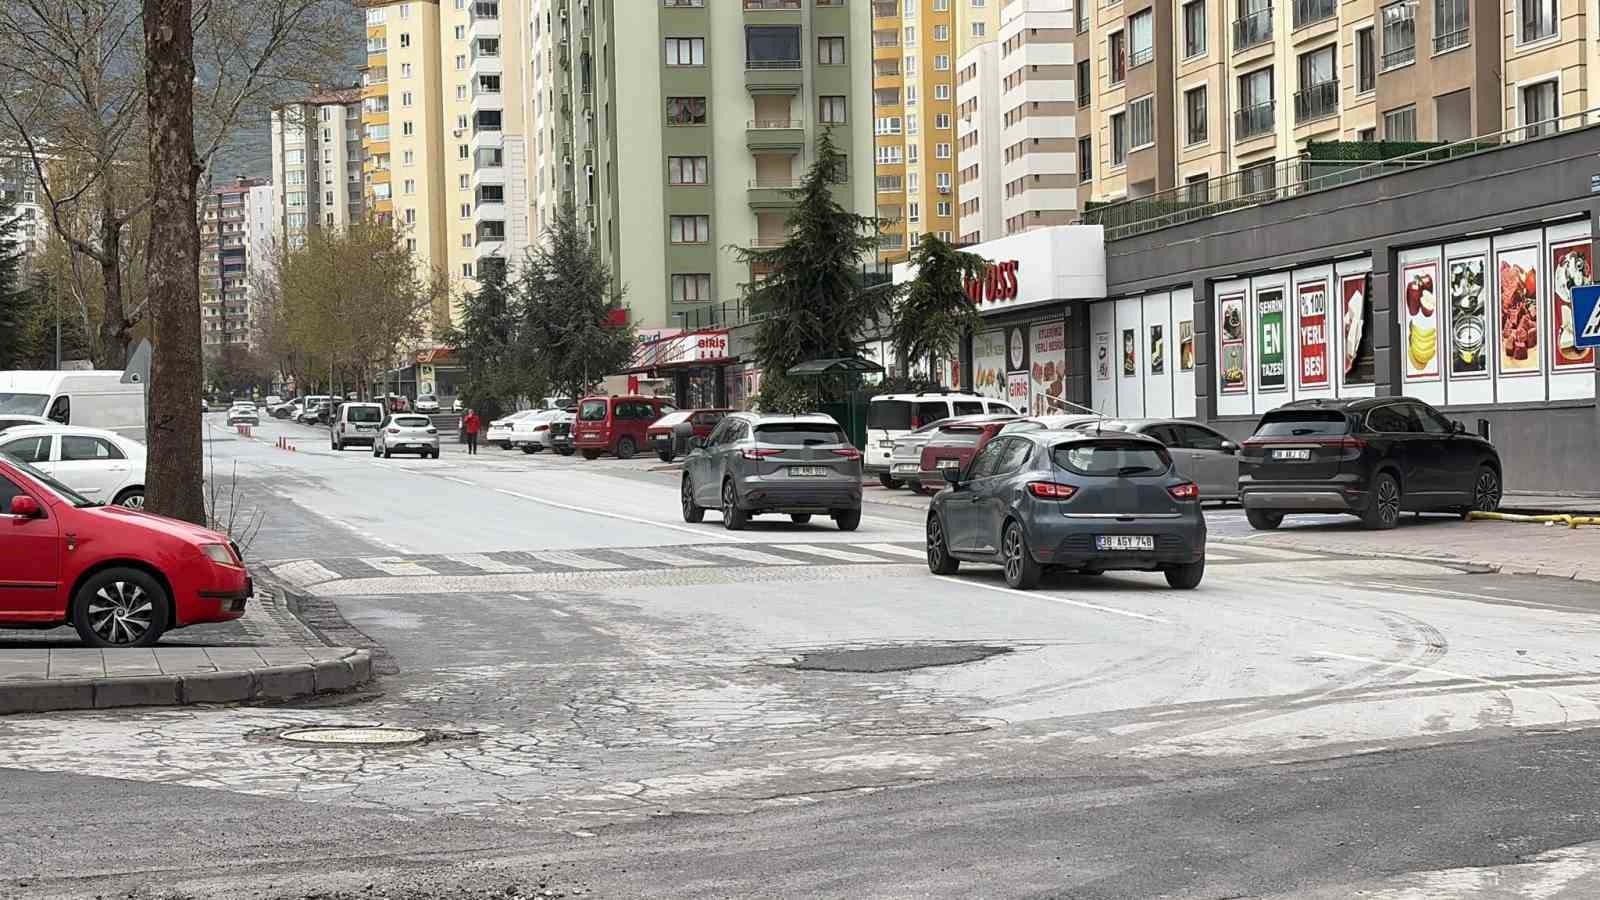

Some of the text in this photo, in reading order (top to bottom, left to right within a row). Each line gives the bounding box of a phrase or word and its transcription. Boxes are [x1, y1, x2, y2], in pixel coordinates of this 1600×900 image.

[1310, 293, 1323, 313] 100
[698, 337, 726, 349] GİRİŞ
[1263, 323, 1281, 354] EN
[1301, 320, 1327, 345] YERLİ
[1009, 378, 1028, 400] GİRİŞ
[1102, 536, 1112, 546] 38
